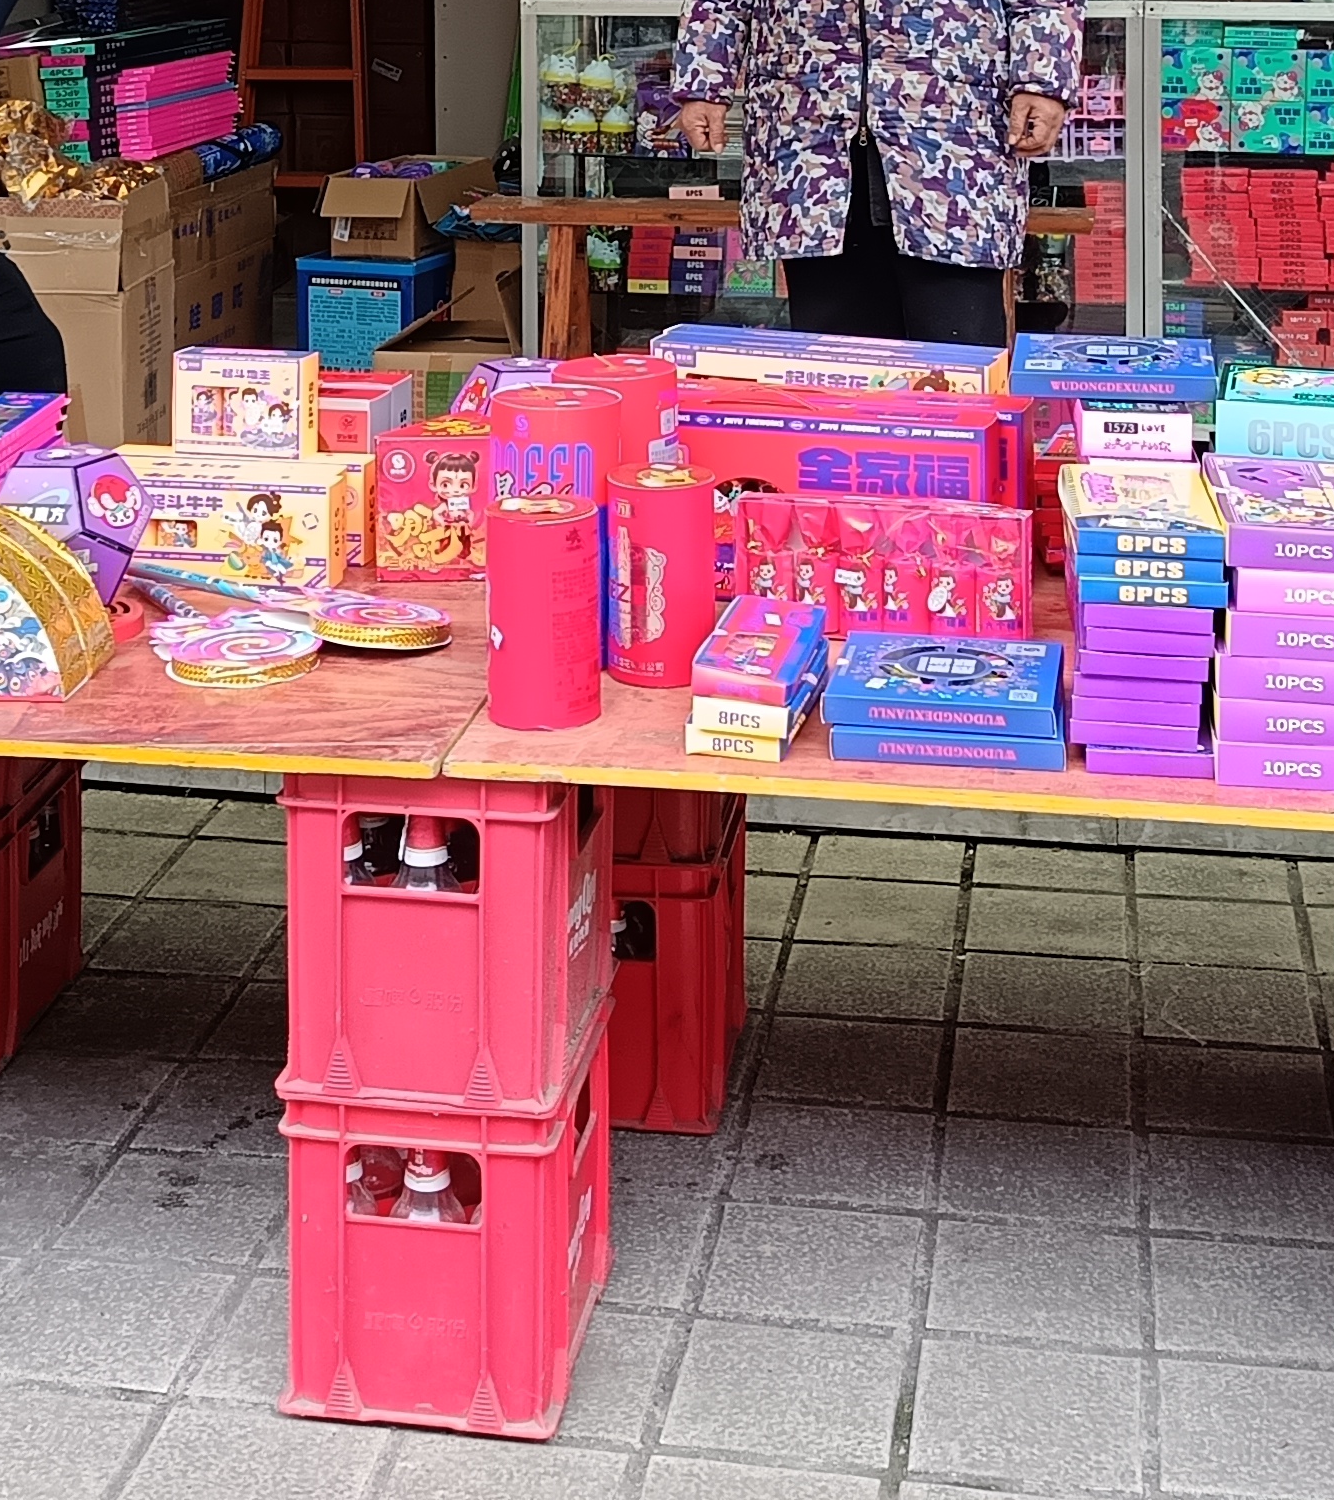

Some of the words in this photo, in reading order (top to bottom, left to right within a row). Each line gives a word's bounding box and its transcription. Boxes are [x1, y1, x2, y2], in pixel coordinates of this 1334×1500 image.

[210, 369, 270, 380] 一起斗地主
[1106, 423, 1136, 434] 1573
[798, 446, 970, 497] 全家福
[1274, 542, 1333, 560] 10PCS
[1276, 632, 1334, 649] 10PCS
[1266, 674, 1324, 692] 10PCS
[718, 711, 761, 729] 8PCS
[1266, 718, 1325, 734] 10PCS
[712, 737, 754, 754] 8PCS
[1263, 761, 1321, 777] 10PCS
